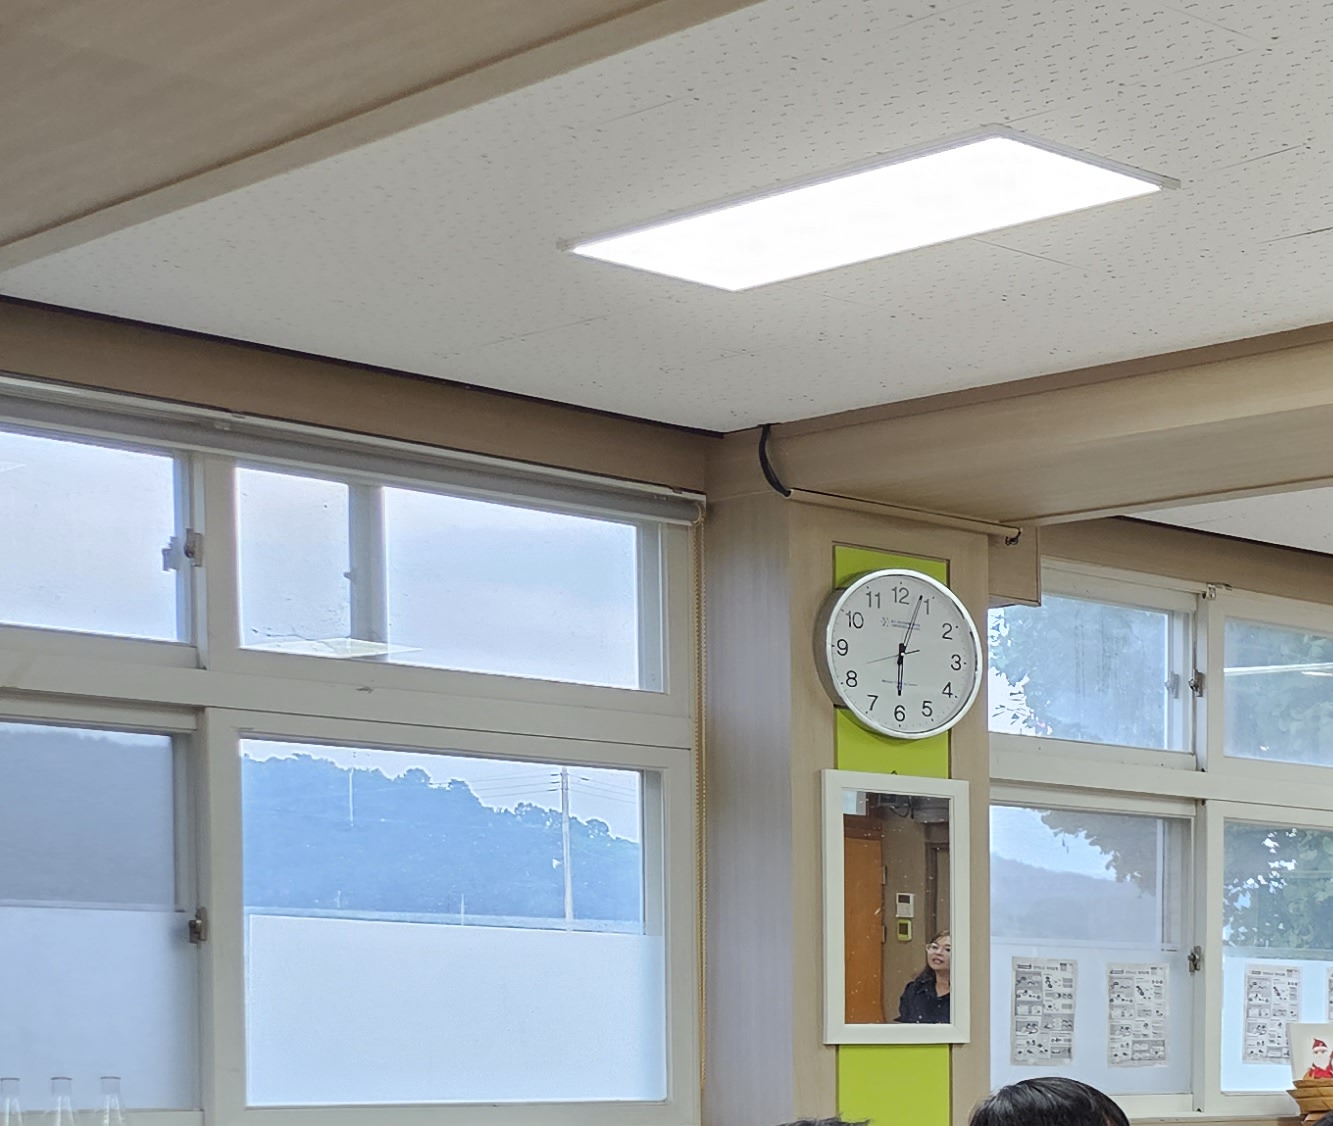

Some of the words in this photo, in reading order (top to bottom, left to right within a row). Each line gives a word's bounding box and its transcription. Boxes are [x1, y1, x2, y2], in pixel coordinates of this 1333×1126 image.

[866, 591, 881, 609] 11
[891, 586, 910, 605] 12
[923, 599, 930, 615] 1
[845, 610, 864, 629] 10
[942, 623, 953, 640] 2
[836, 638, 849, 656] 9
[950, 654, 962, 671] 3
[845, 670, 858, 688] 8
[941, 682, 954, 698] 4
[867, 694, 879, 711] 7
[921, 700, 933, 717] 5
[894, 705, 906, 722] 6
